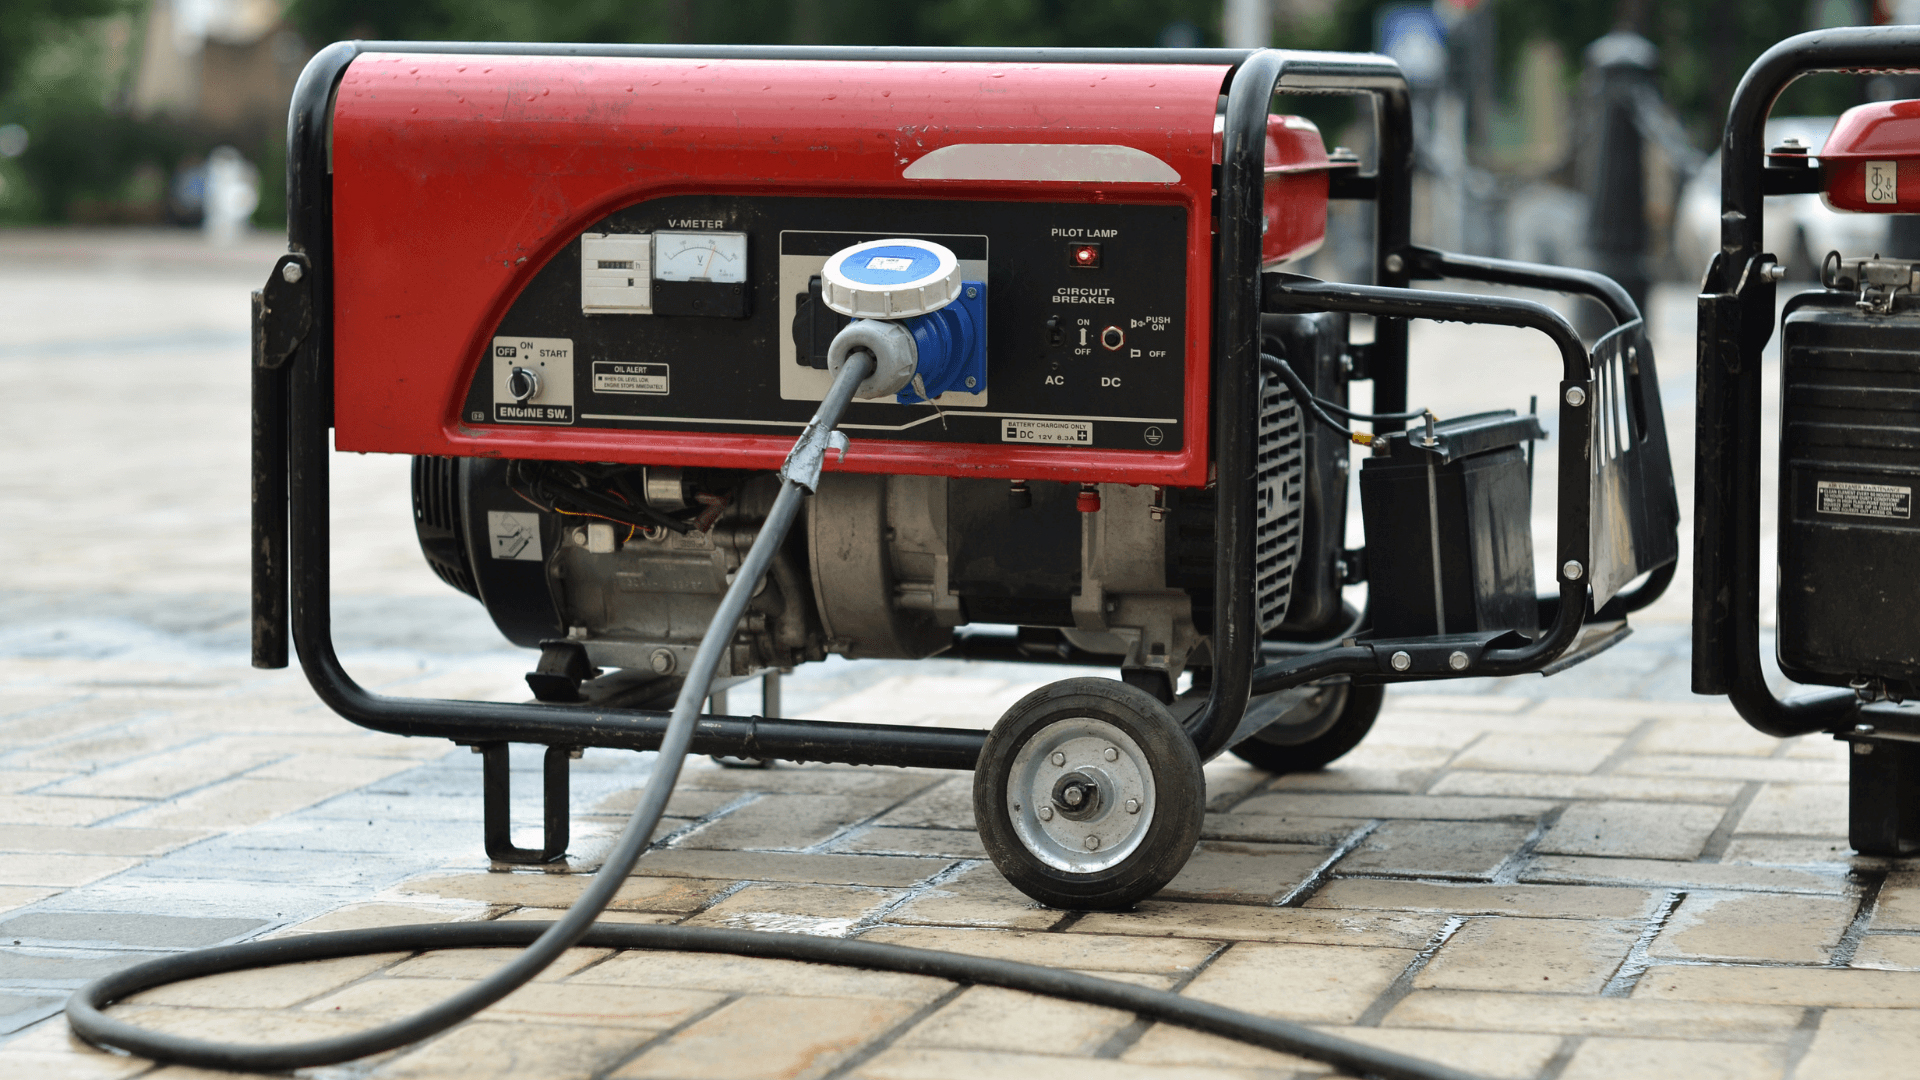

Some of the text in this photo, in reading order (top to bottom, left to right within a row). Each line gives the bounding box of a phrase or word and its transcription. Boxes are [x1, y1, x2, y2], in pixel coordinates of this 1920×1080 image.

[668, 220, 724, 229] V-METER
[1051, 228, 1118, 238] PILOT LAMP
[1057, 288, 1110, 296] CIRCUIT
[1052, 296, 1115, 304] BREAKER
[1146, 316, 1171, 324] PUSH
[520, 342, 533, 350] ON
[497, 348, 515, 356] OFF
[540, 349, 568, 358] START
[1149, 350, 1166, 358] OFF
[626, 366, 647, 374] ALERT
[1045, 375, 1064, 385] AC
[1101, 377, 1121, 387] DC
[500, 407, 568, 419] ENGINE SW.
[1020, 431, 1034, 439] DC
